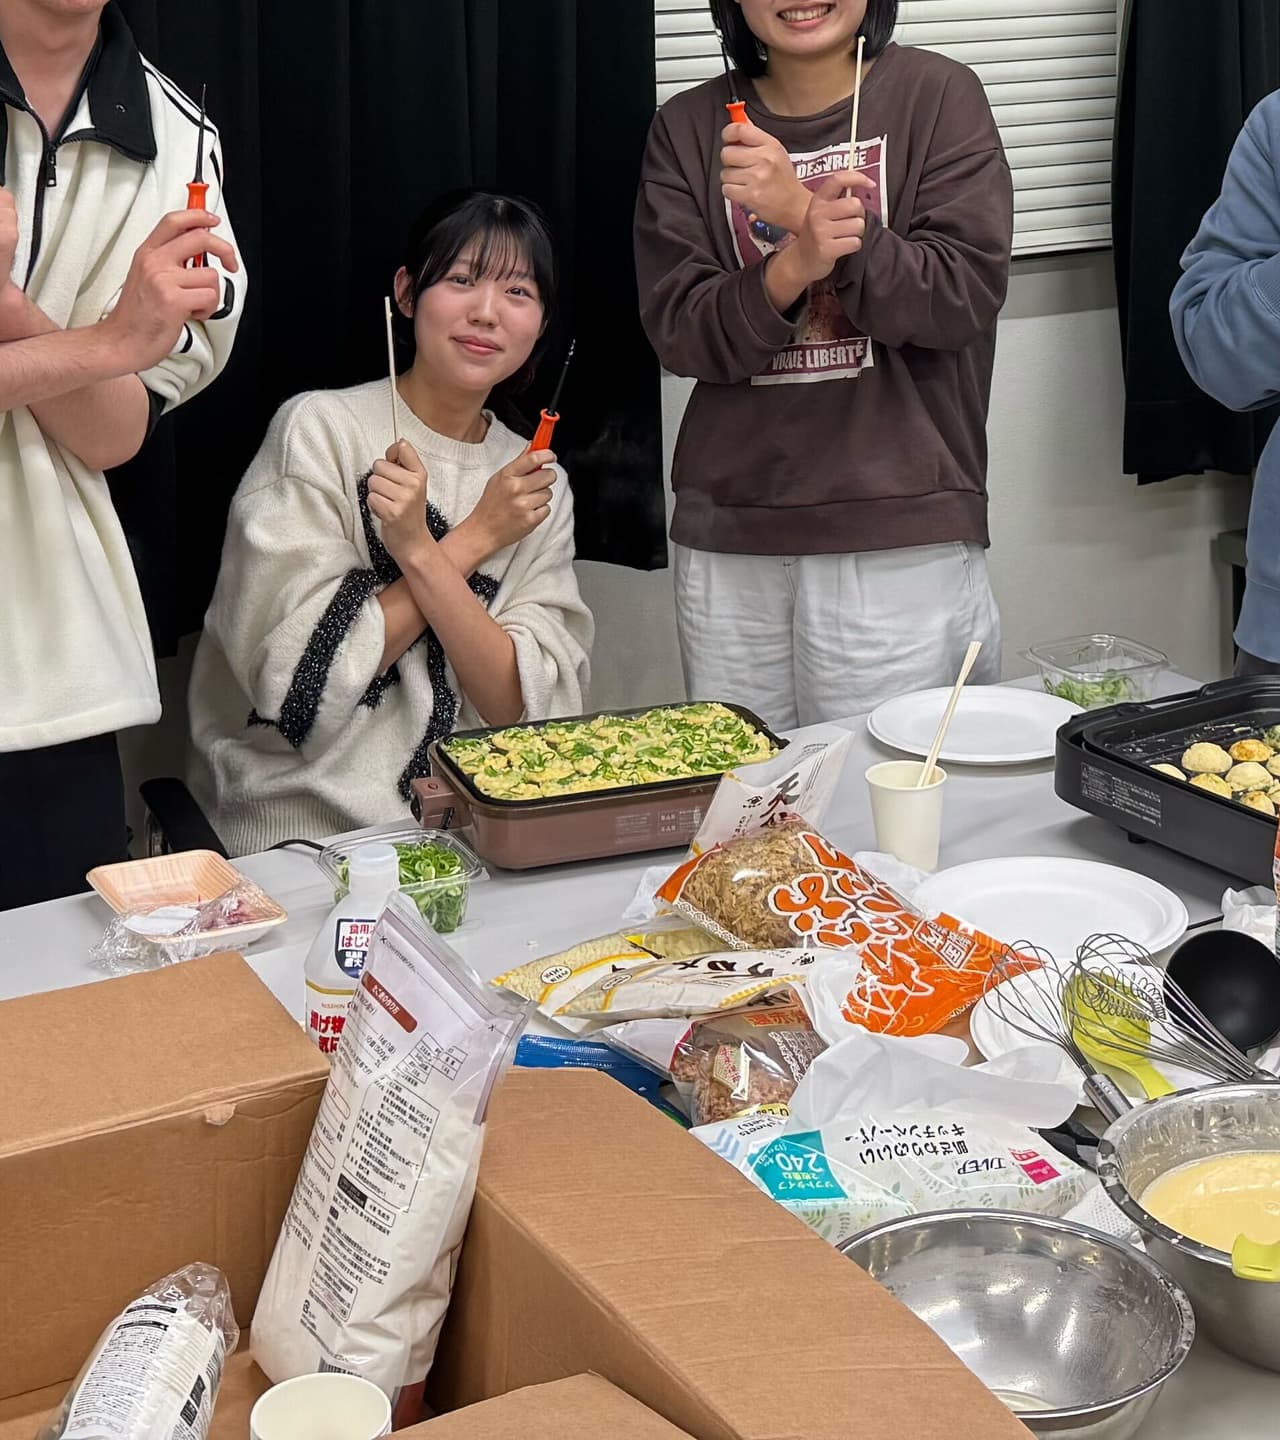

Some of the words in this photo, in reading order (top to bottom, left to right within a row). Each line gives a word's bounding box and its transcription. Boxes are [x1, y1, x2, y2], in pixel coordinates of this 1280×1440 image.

[805, 341, 864, 369] LIBERTÉ
[844, 1123, 966, 1145] キッチンペーパー
[859, 1140, 970, 1165] 肌ざわりのいい
[957, 1157, 1008, 1175] エルモア
